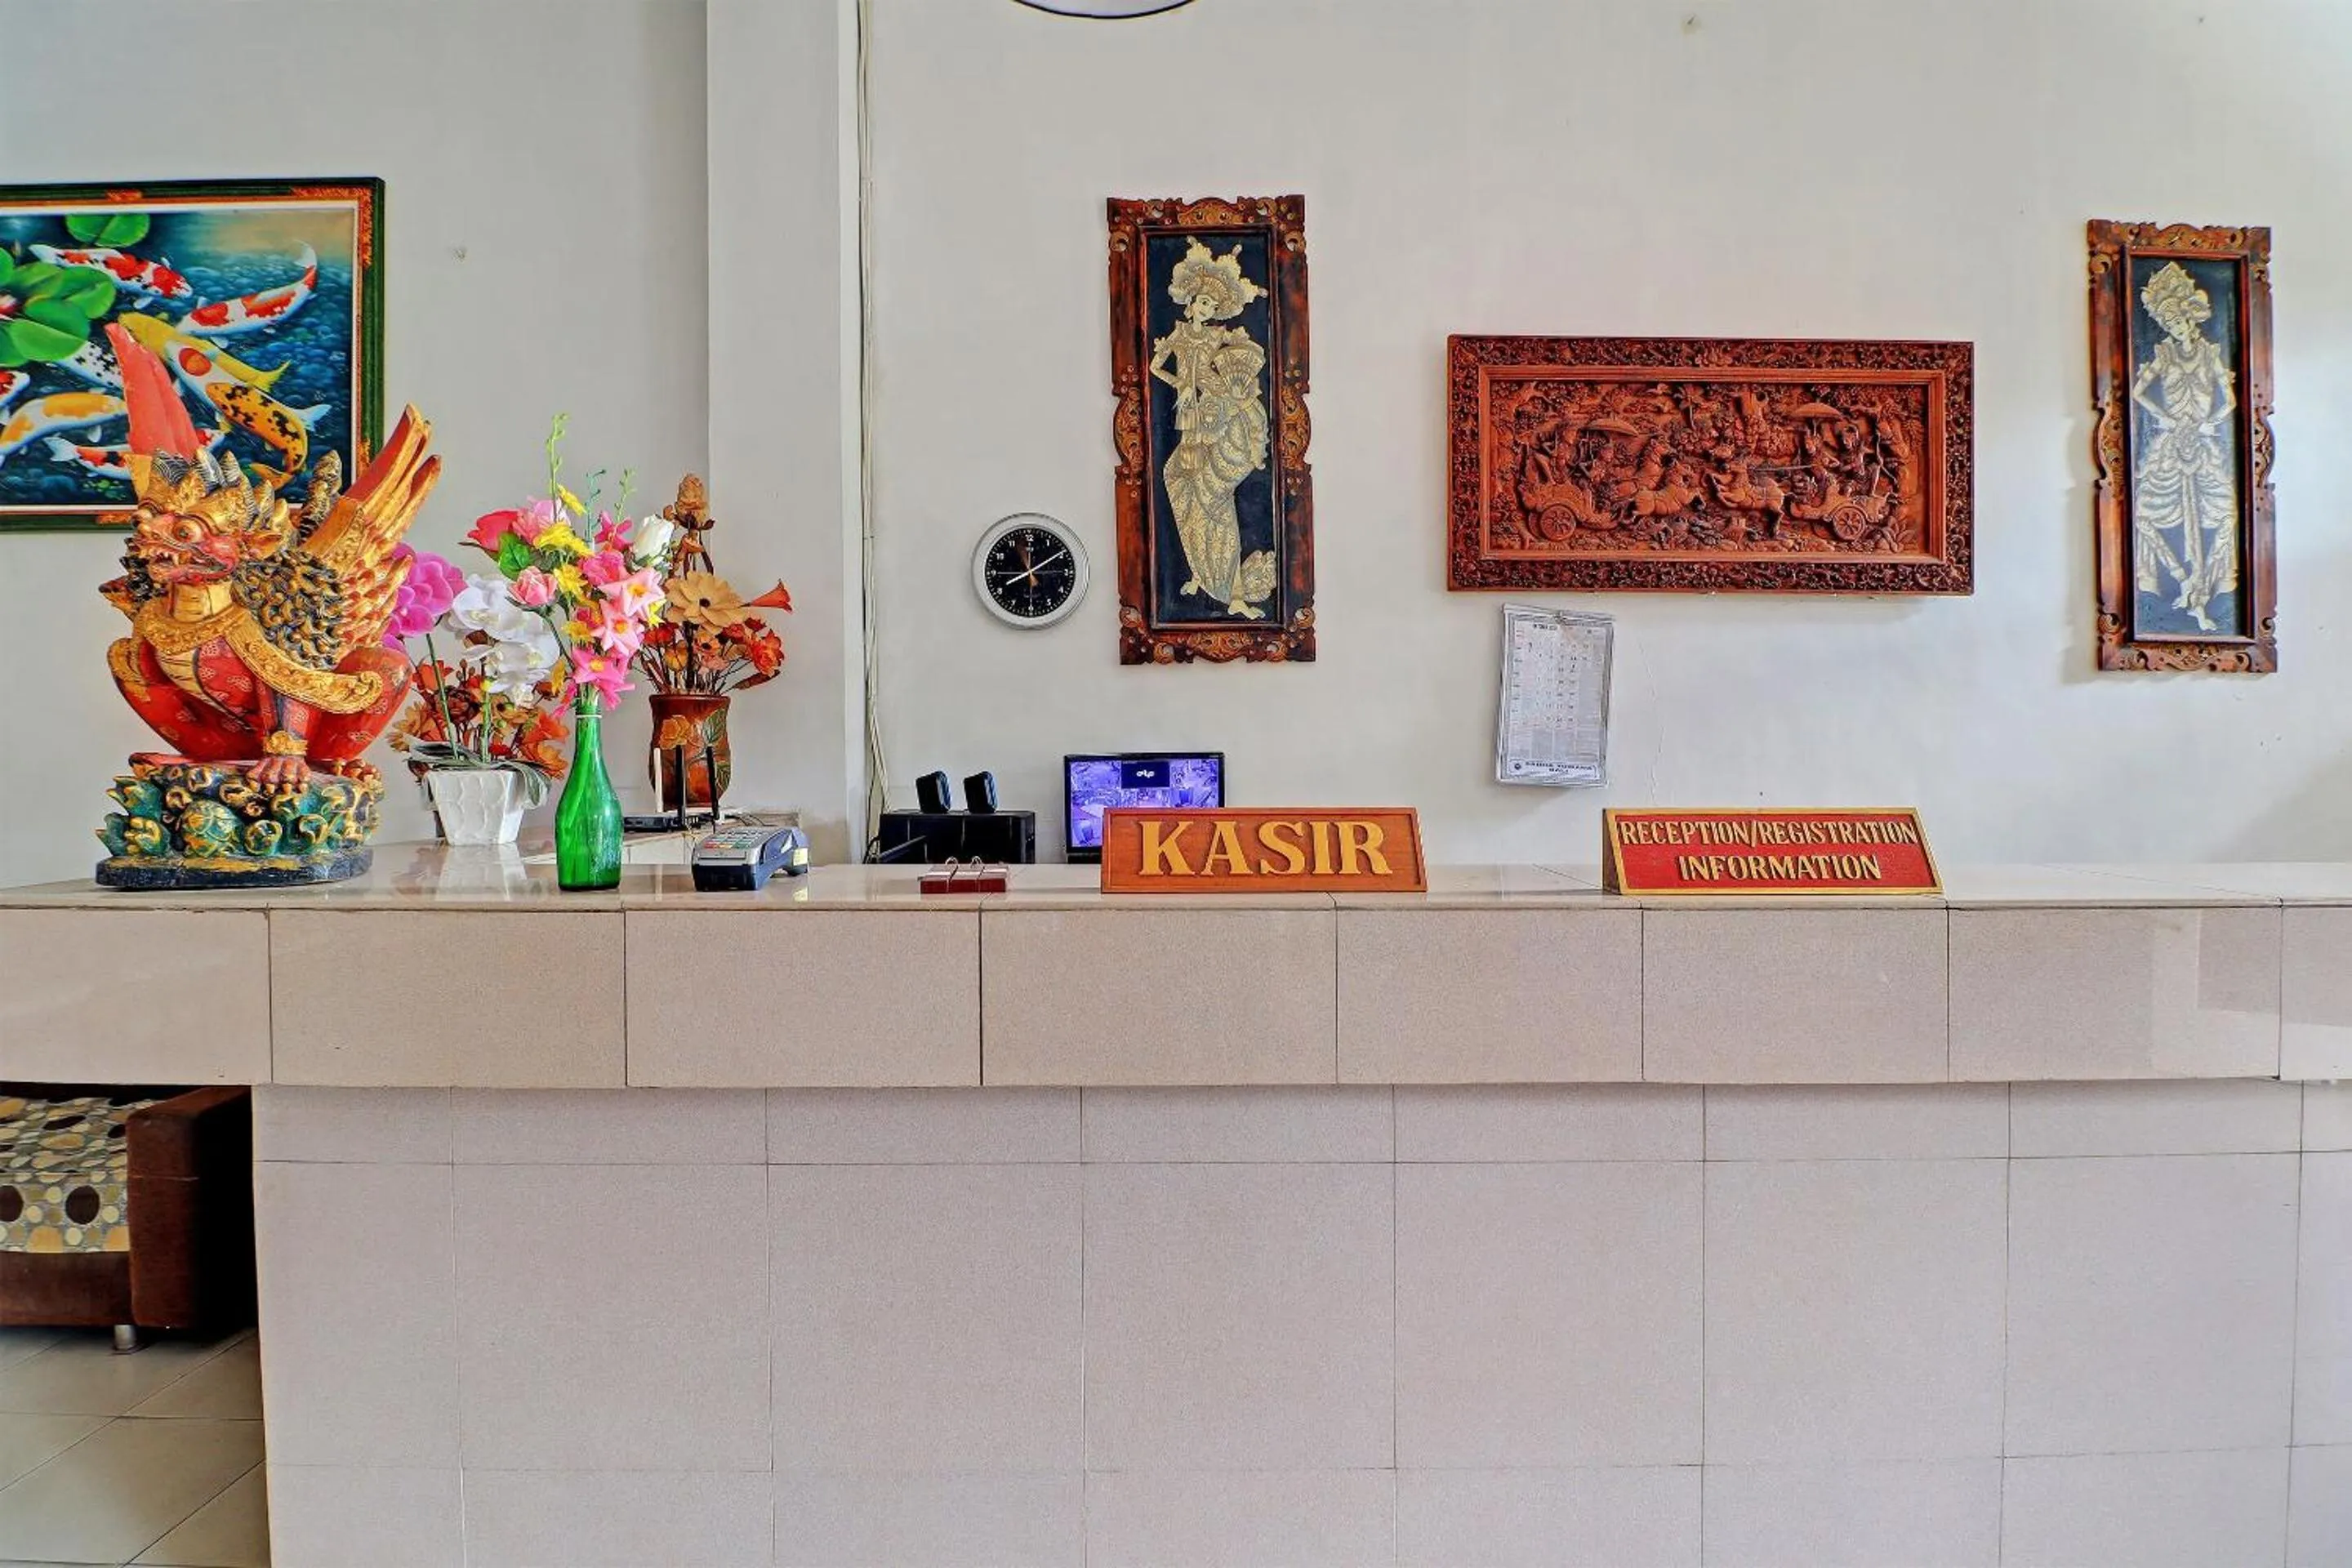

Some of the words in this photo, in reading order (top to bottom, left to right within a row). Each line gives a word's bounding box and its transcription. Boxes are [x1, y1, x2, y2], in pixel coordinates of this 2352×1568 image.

[1008, 540, 1015, 548] 11
[1025, 534, 1034, 542] 12
[1058, 586, 1064, 594] 4
[1620, 821, 1919, 847] RECEPTION/REGISTRATION
[1138, 821, 1393, 875] KASIR
[1677, 855, 1882, 881] INFORMATION
